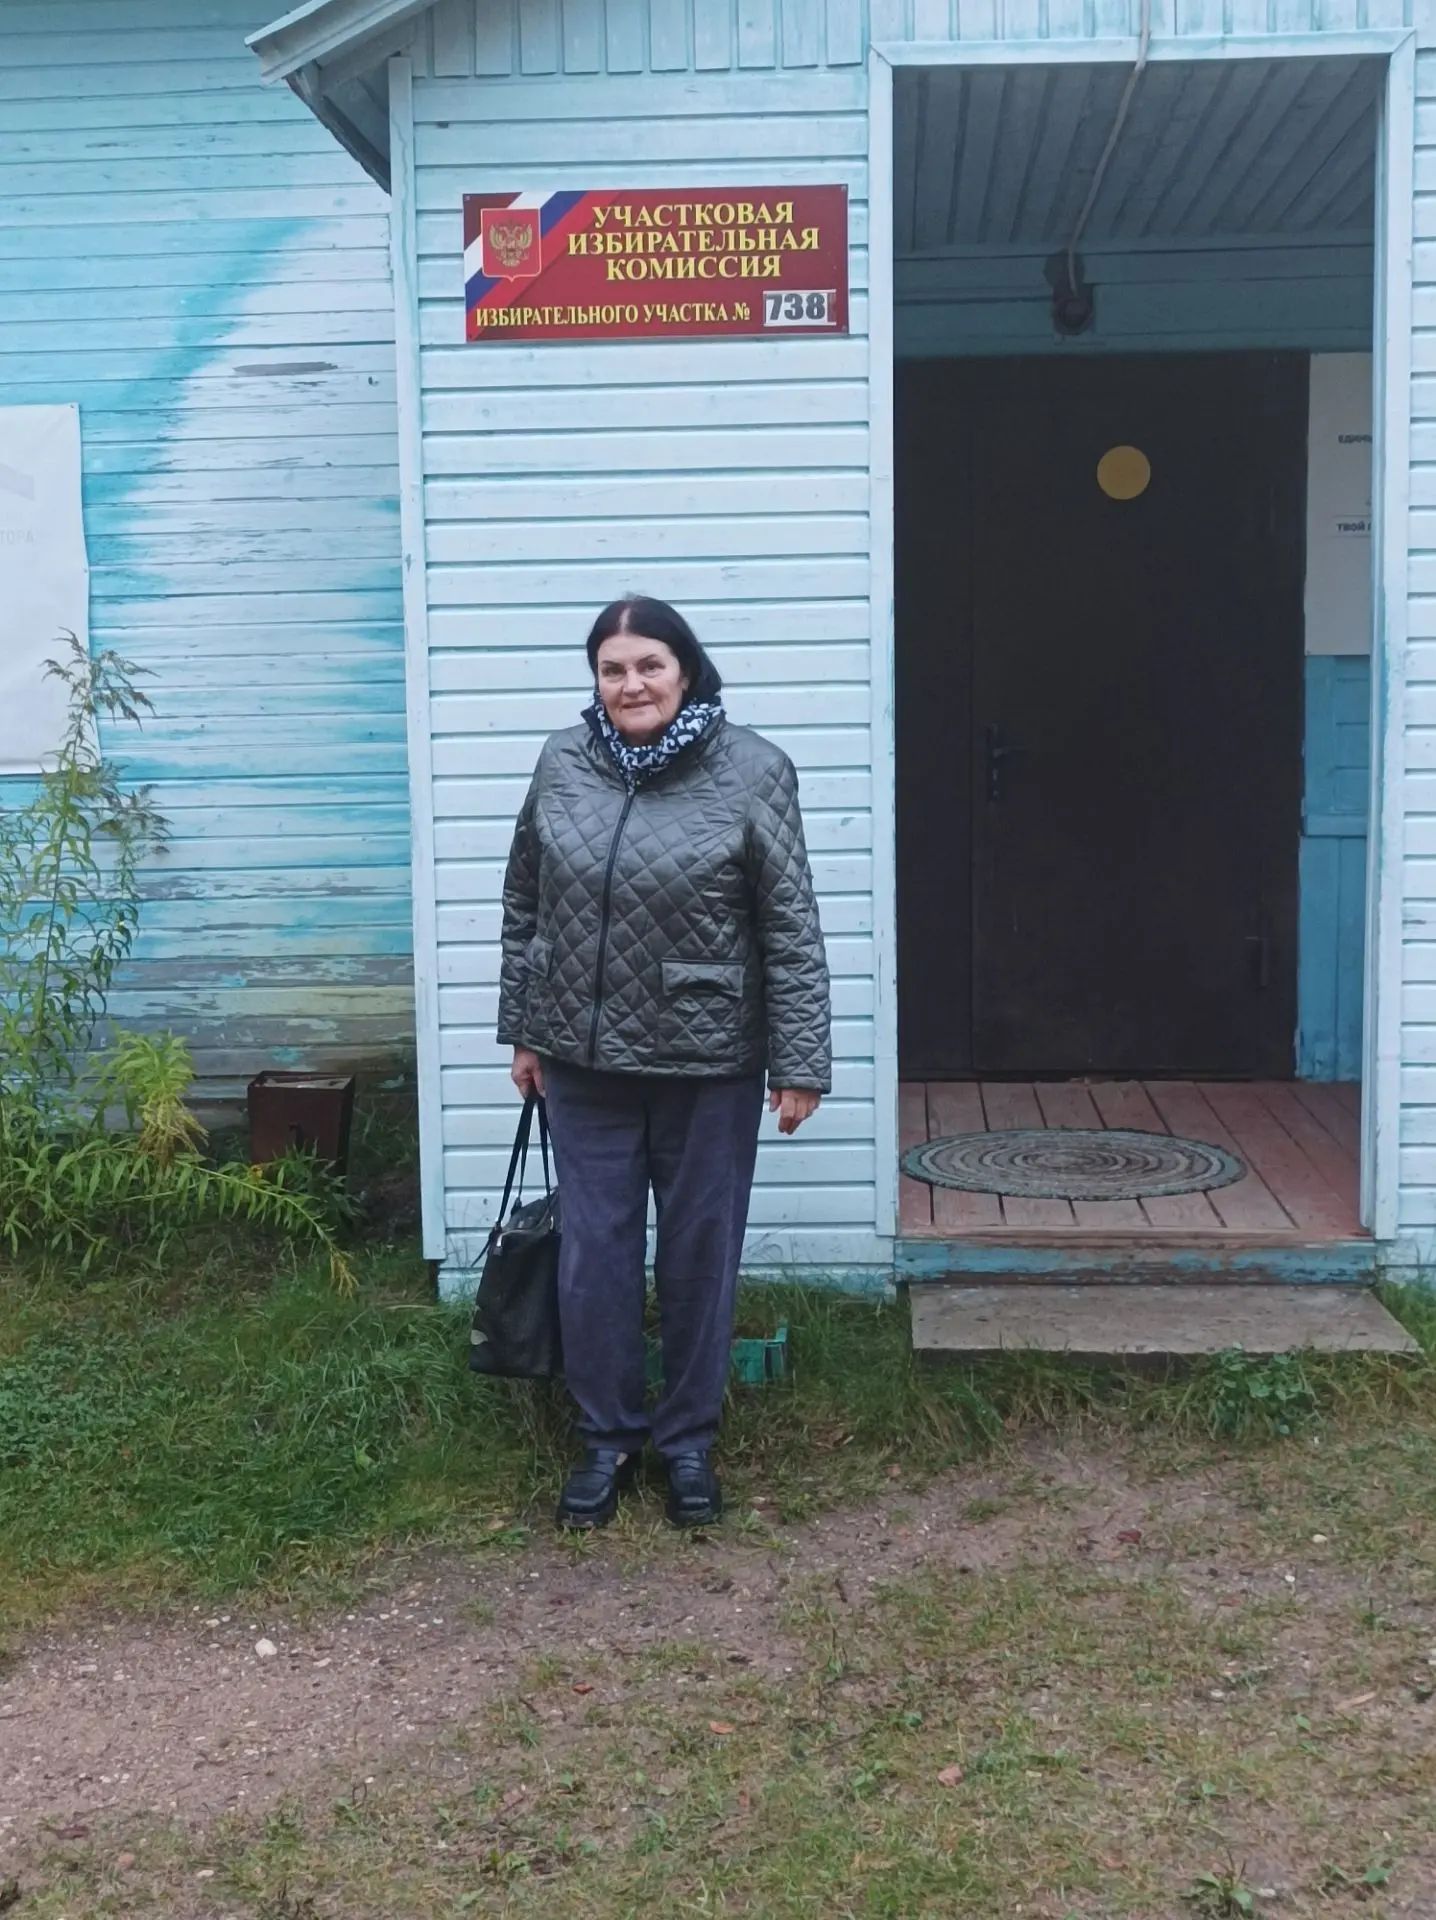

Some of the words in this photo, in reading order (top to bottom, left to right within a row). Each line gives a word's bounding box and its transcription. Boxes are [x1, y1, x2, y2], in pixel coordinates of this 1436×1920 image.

[592, 202, 794, 228] УЧАСТКОВАЯ
[568, 227, 819, 255] ИЗБИРАТЕЛЬНАЯ
[605, 254, 781, 281] КОМИССИЯ
[476, 304, 638, 327] ИЗБИРАТЕЛЬНОГО
[643, 302, 727, 323] УЧАСТКА
[766, 293, 825, 320] 738
